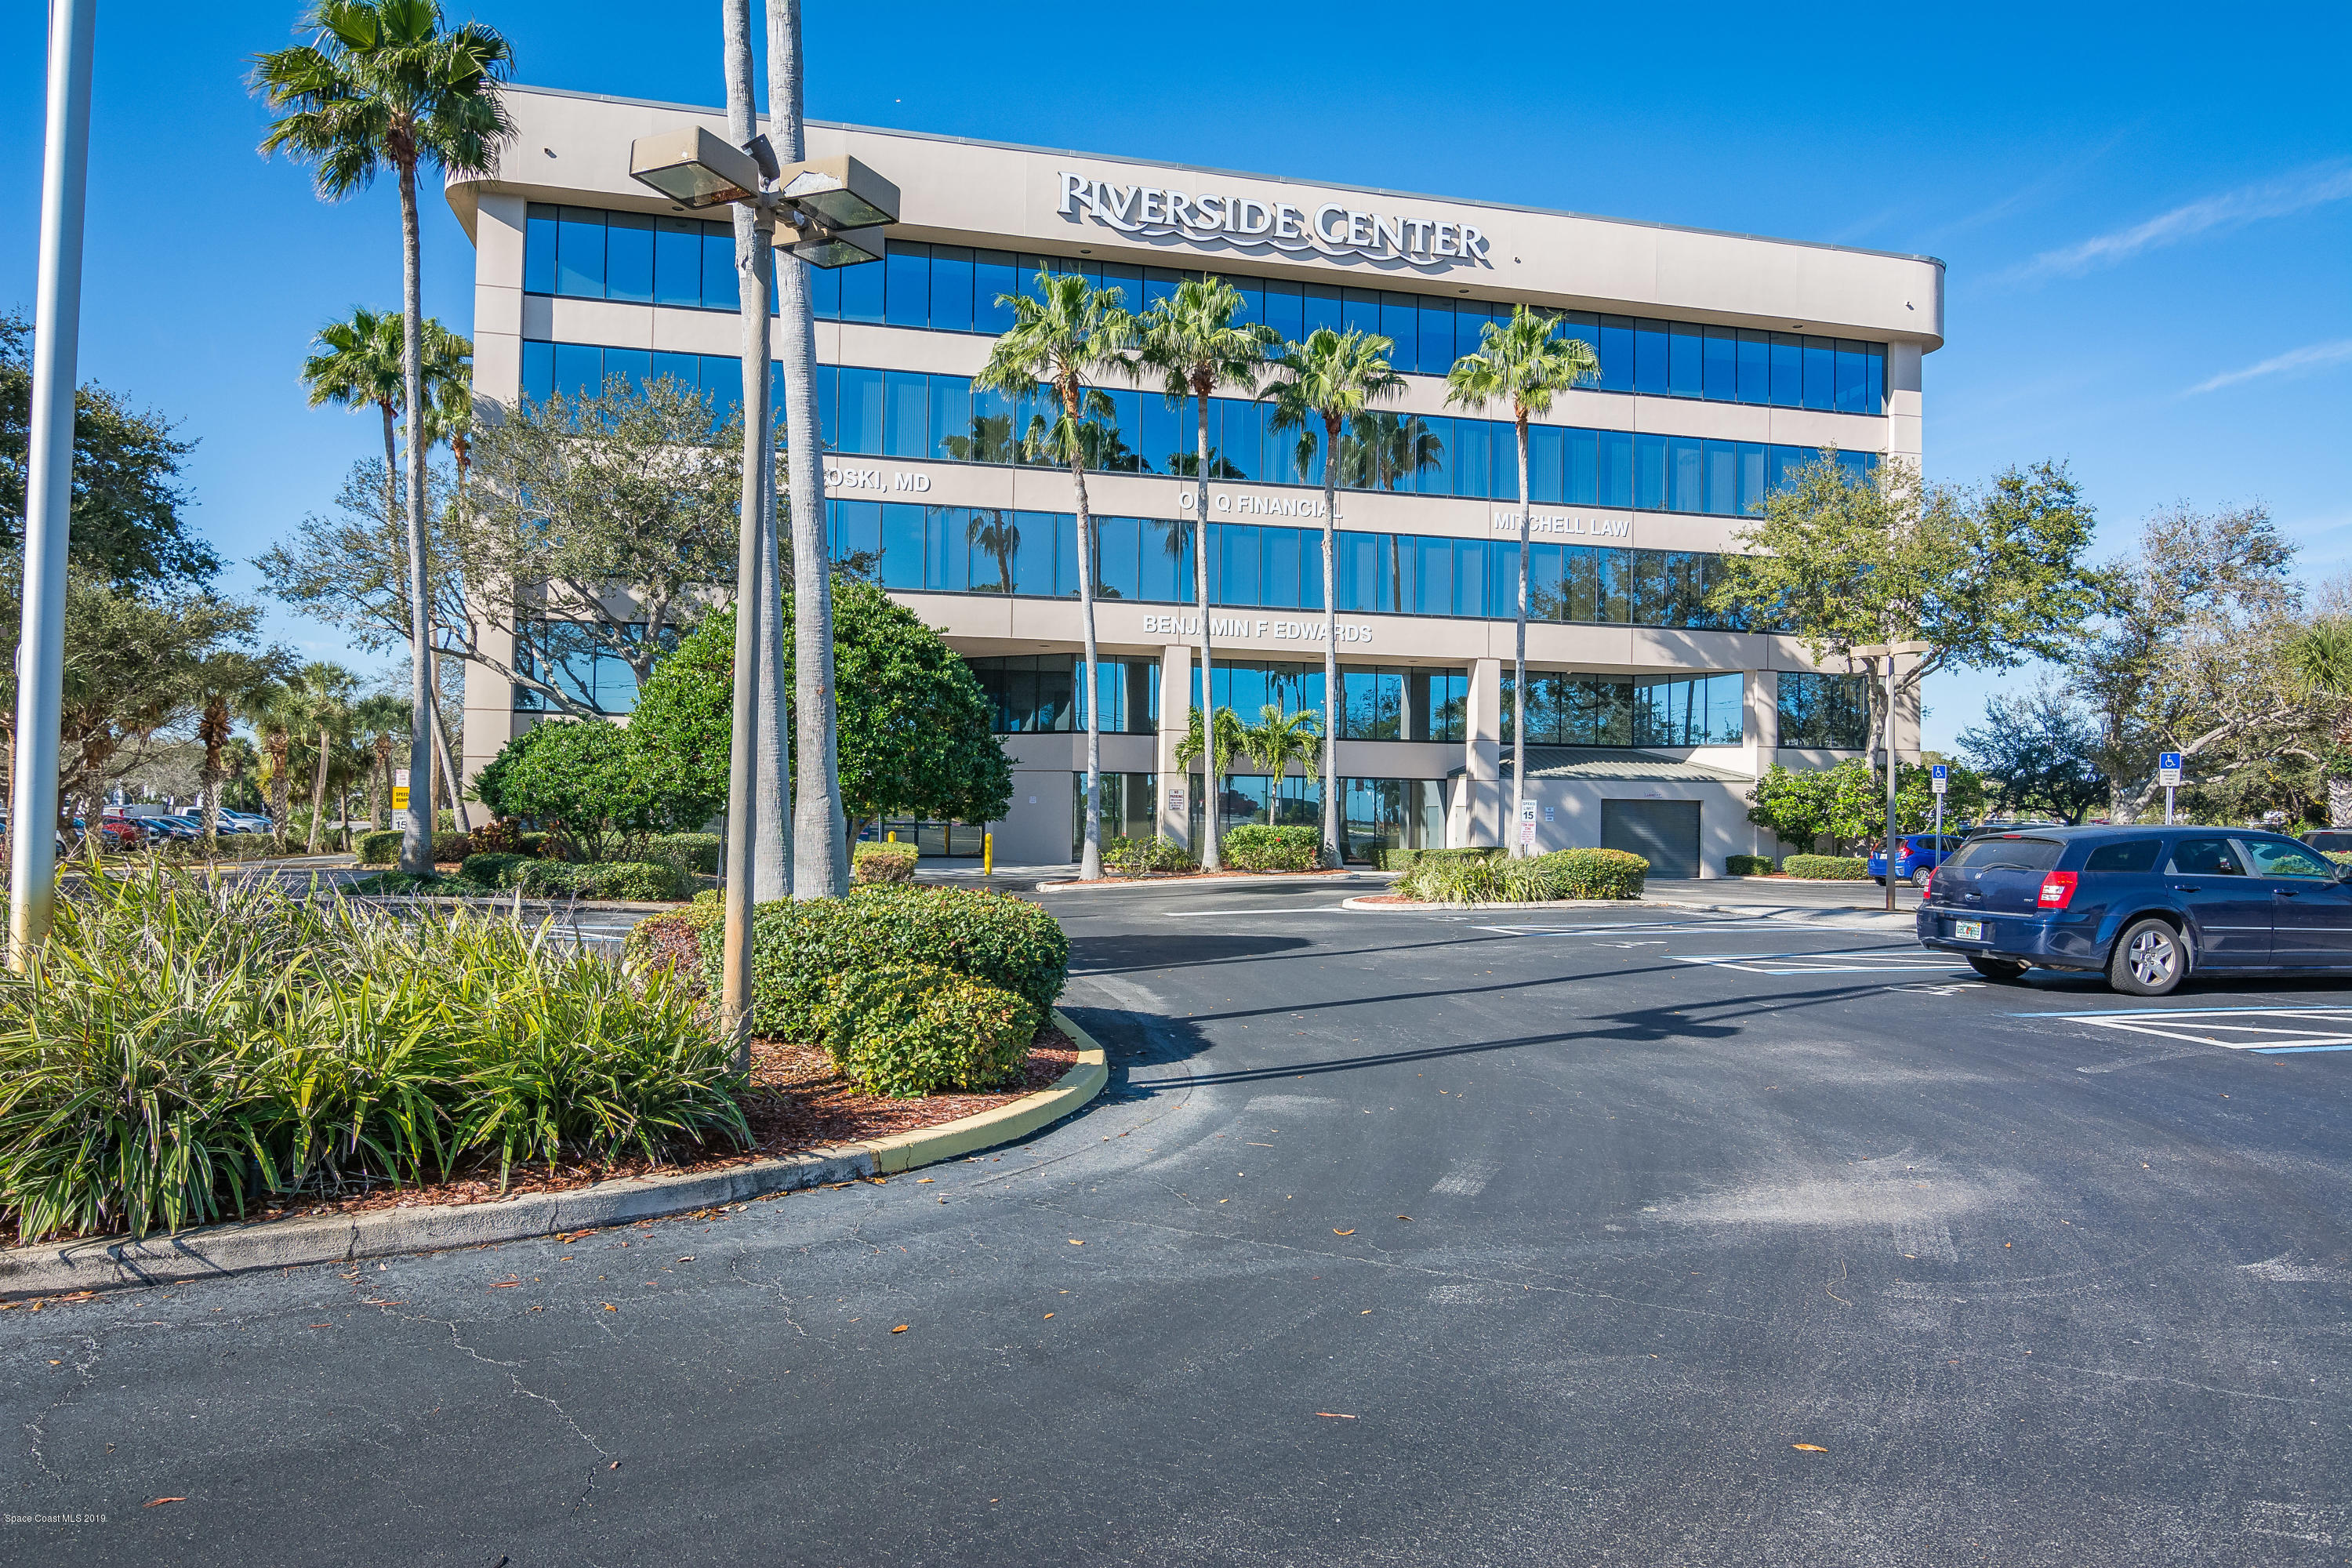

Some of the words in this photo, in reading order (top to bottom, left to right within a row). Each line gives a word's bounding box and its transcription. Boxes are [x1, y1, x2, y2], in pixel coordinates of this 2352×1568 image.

[1057, 170, 1300, 239] RIVERSIDE
[1314, 201, 1488, 261] CENTER
[895, 471, 931, 492] MD
[1215, 493, 1232, 514] Q
[1590, 518, 1630, 538] LAW
[1143, 614, 1250, 638] BENJMIN
[1256, 619, 1269, 638] F
[395, 820, 407, 829] 15
[1523, 811, 1534, 819] 15
